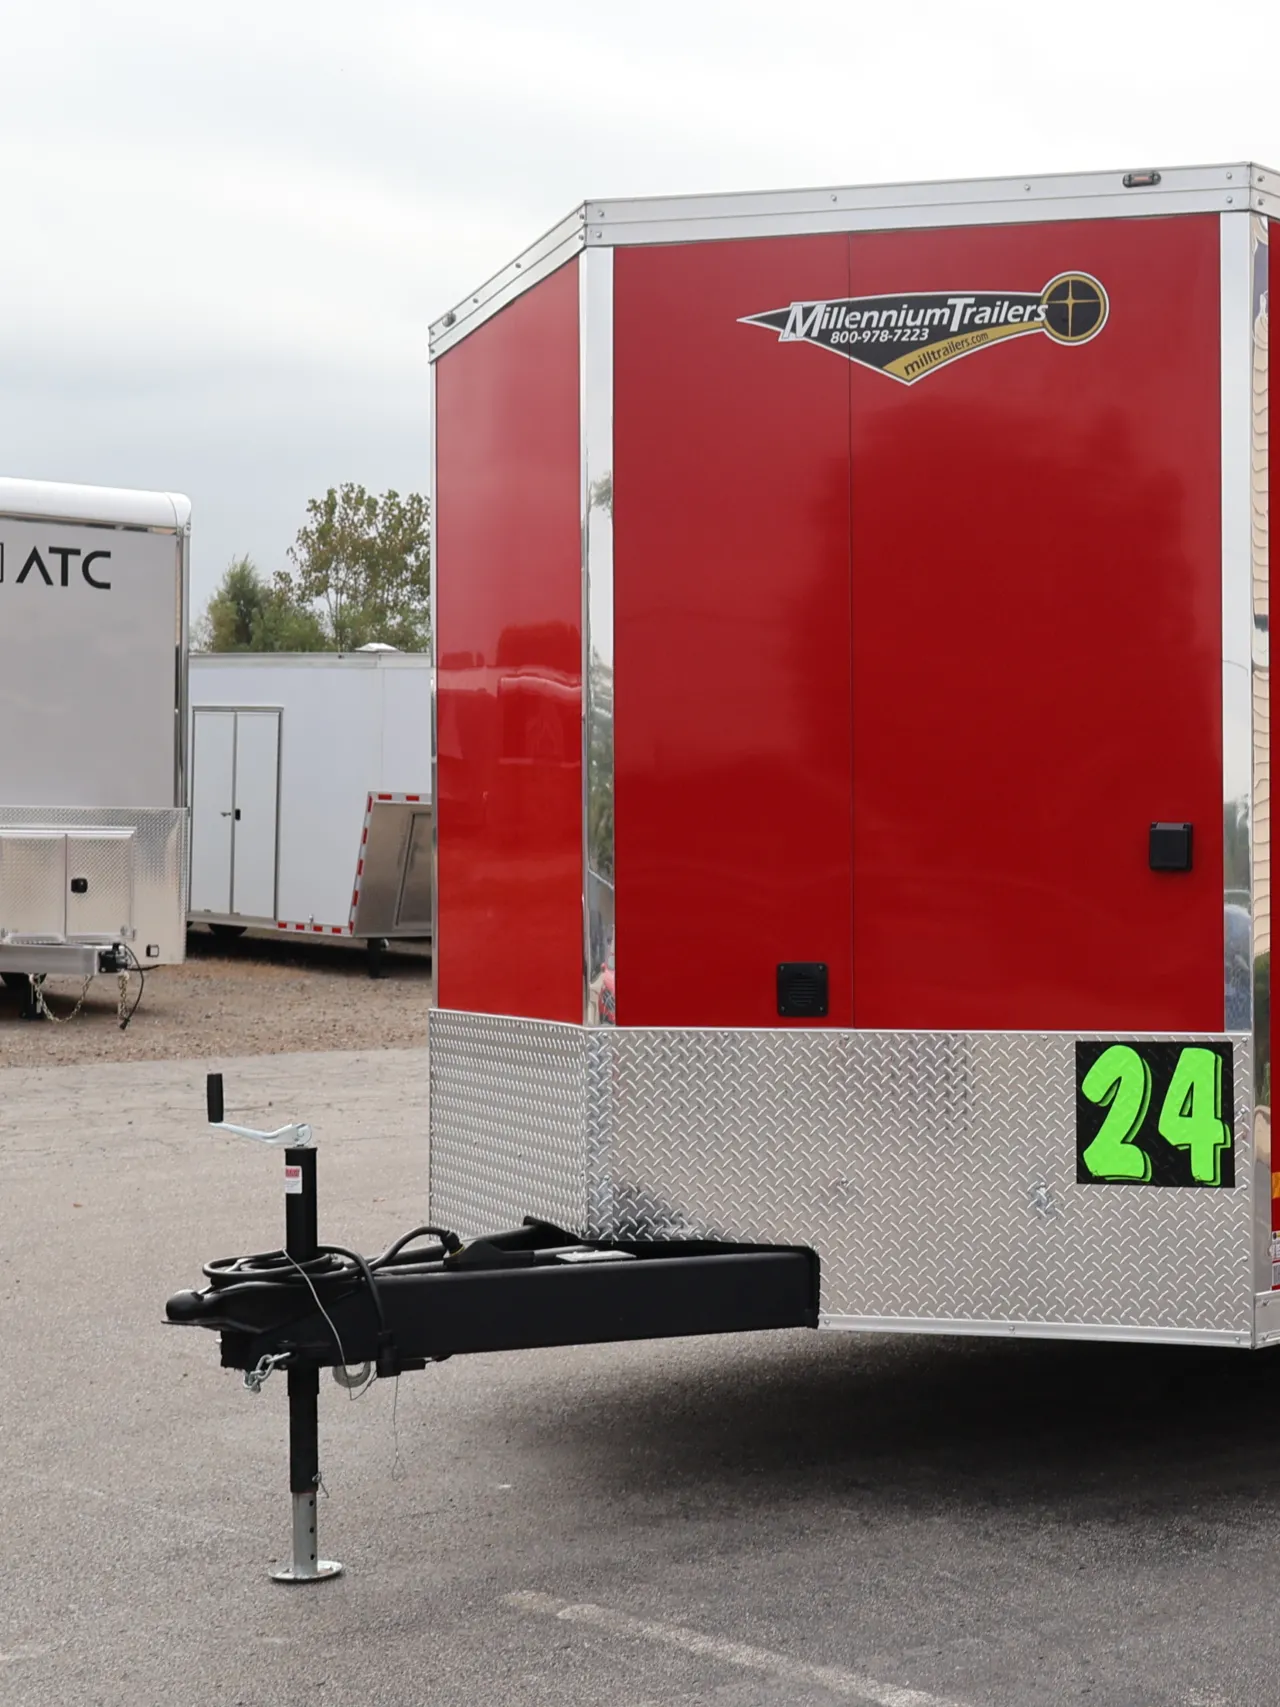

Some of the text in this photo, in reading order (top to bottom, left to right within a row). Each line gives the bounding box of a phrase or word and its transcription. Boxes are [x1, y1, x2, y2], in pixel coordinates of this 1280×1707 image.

[830, 328, 929, 344] 800-978-7223
[904, 332, 989, 376] milltrailers.com
[15, 545, 111, 590] ATC
[1082, 1044, 1231, 1186] 24
